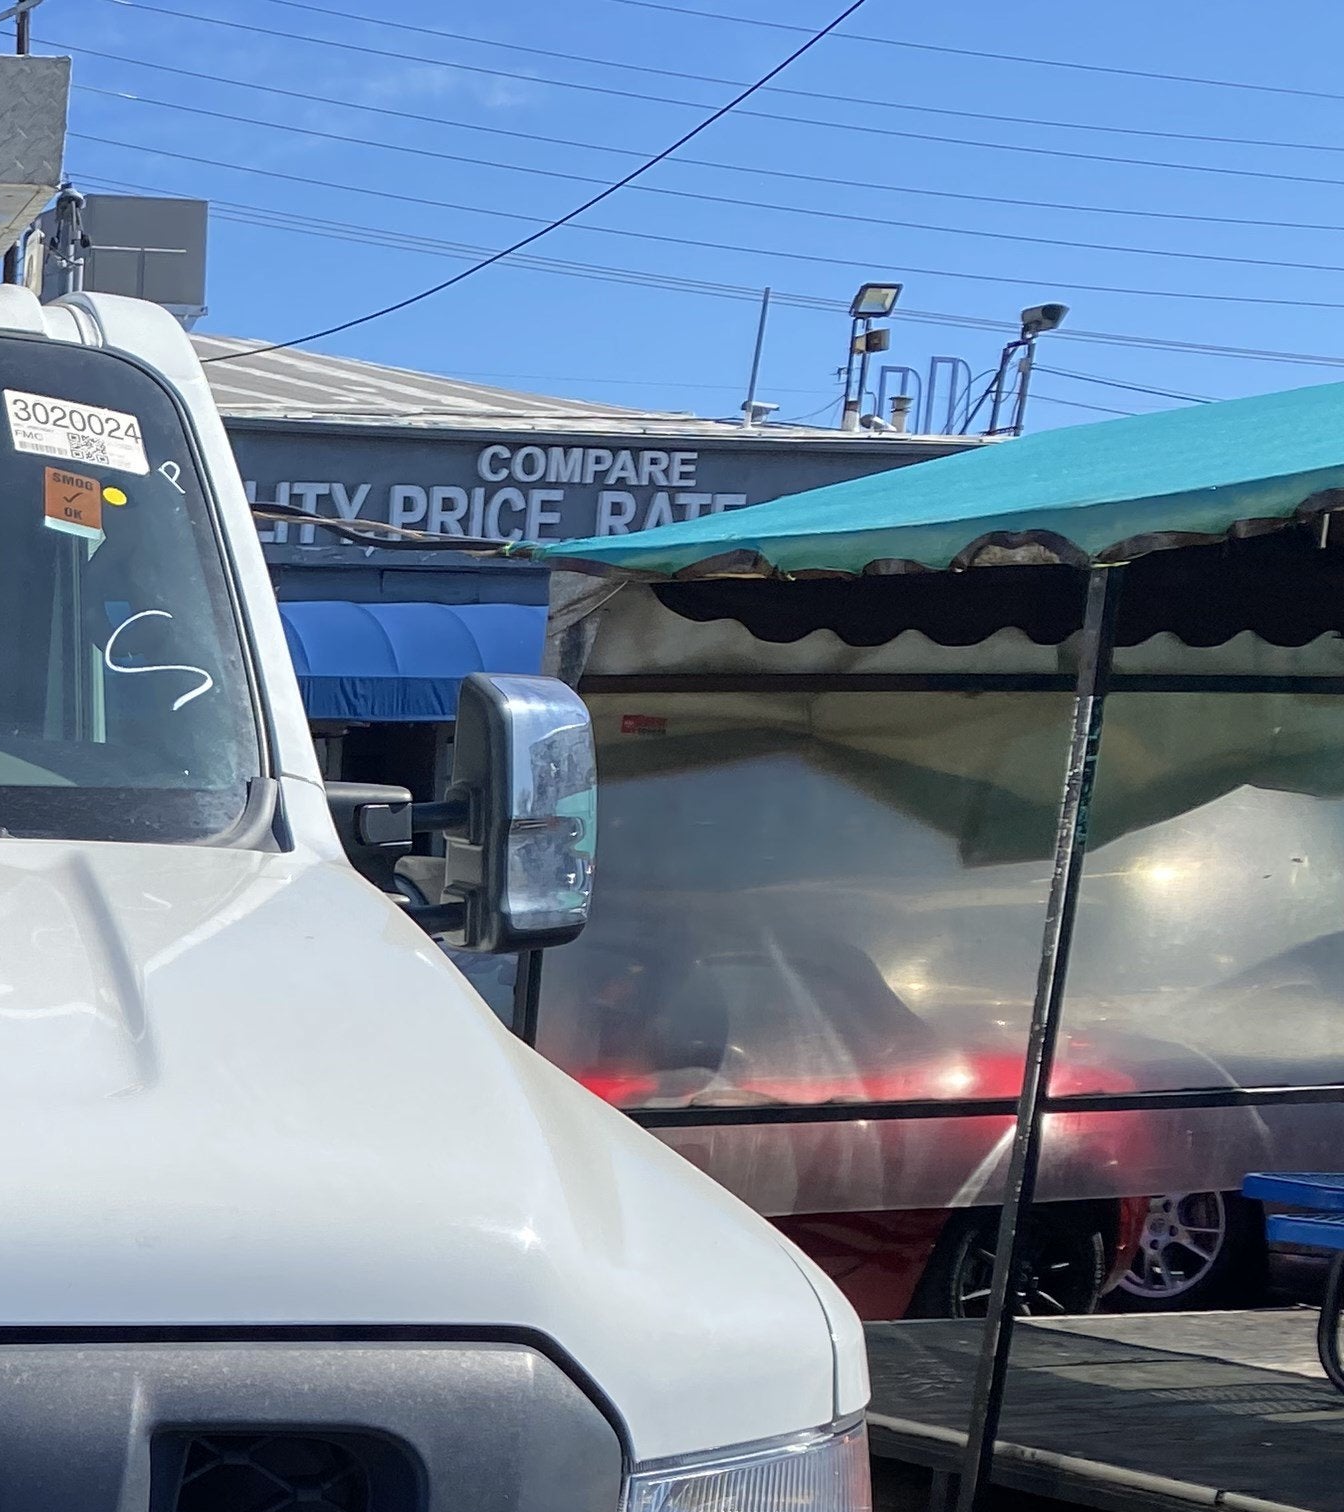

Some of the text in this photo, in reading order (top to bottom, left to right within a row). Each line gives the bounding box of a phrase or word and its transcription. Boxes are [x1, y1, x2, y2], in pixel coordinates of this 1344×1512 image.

[12, 398, 142, 444] 3020024
[52, 472, 94, 491] SMOG
[476, 444, 697, 488] COMPARE
[63, 506, 83, 520] OK
[387, 484, 564, 544] PRICE
